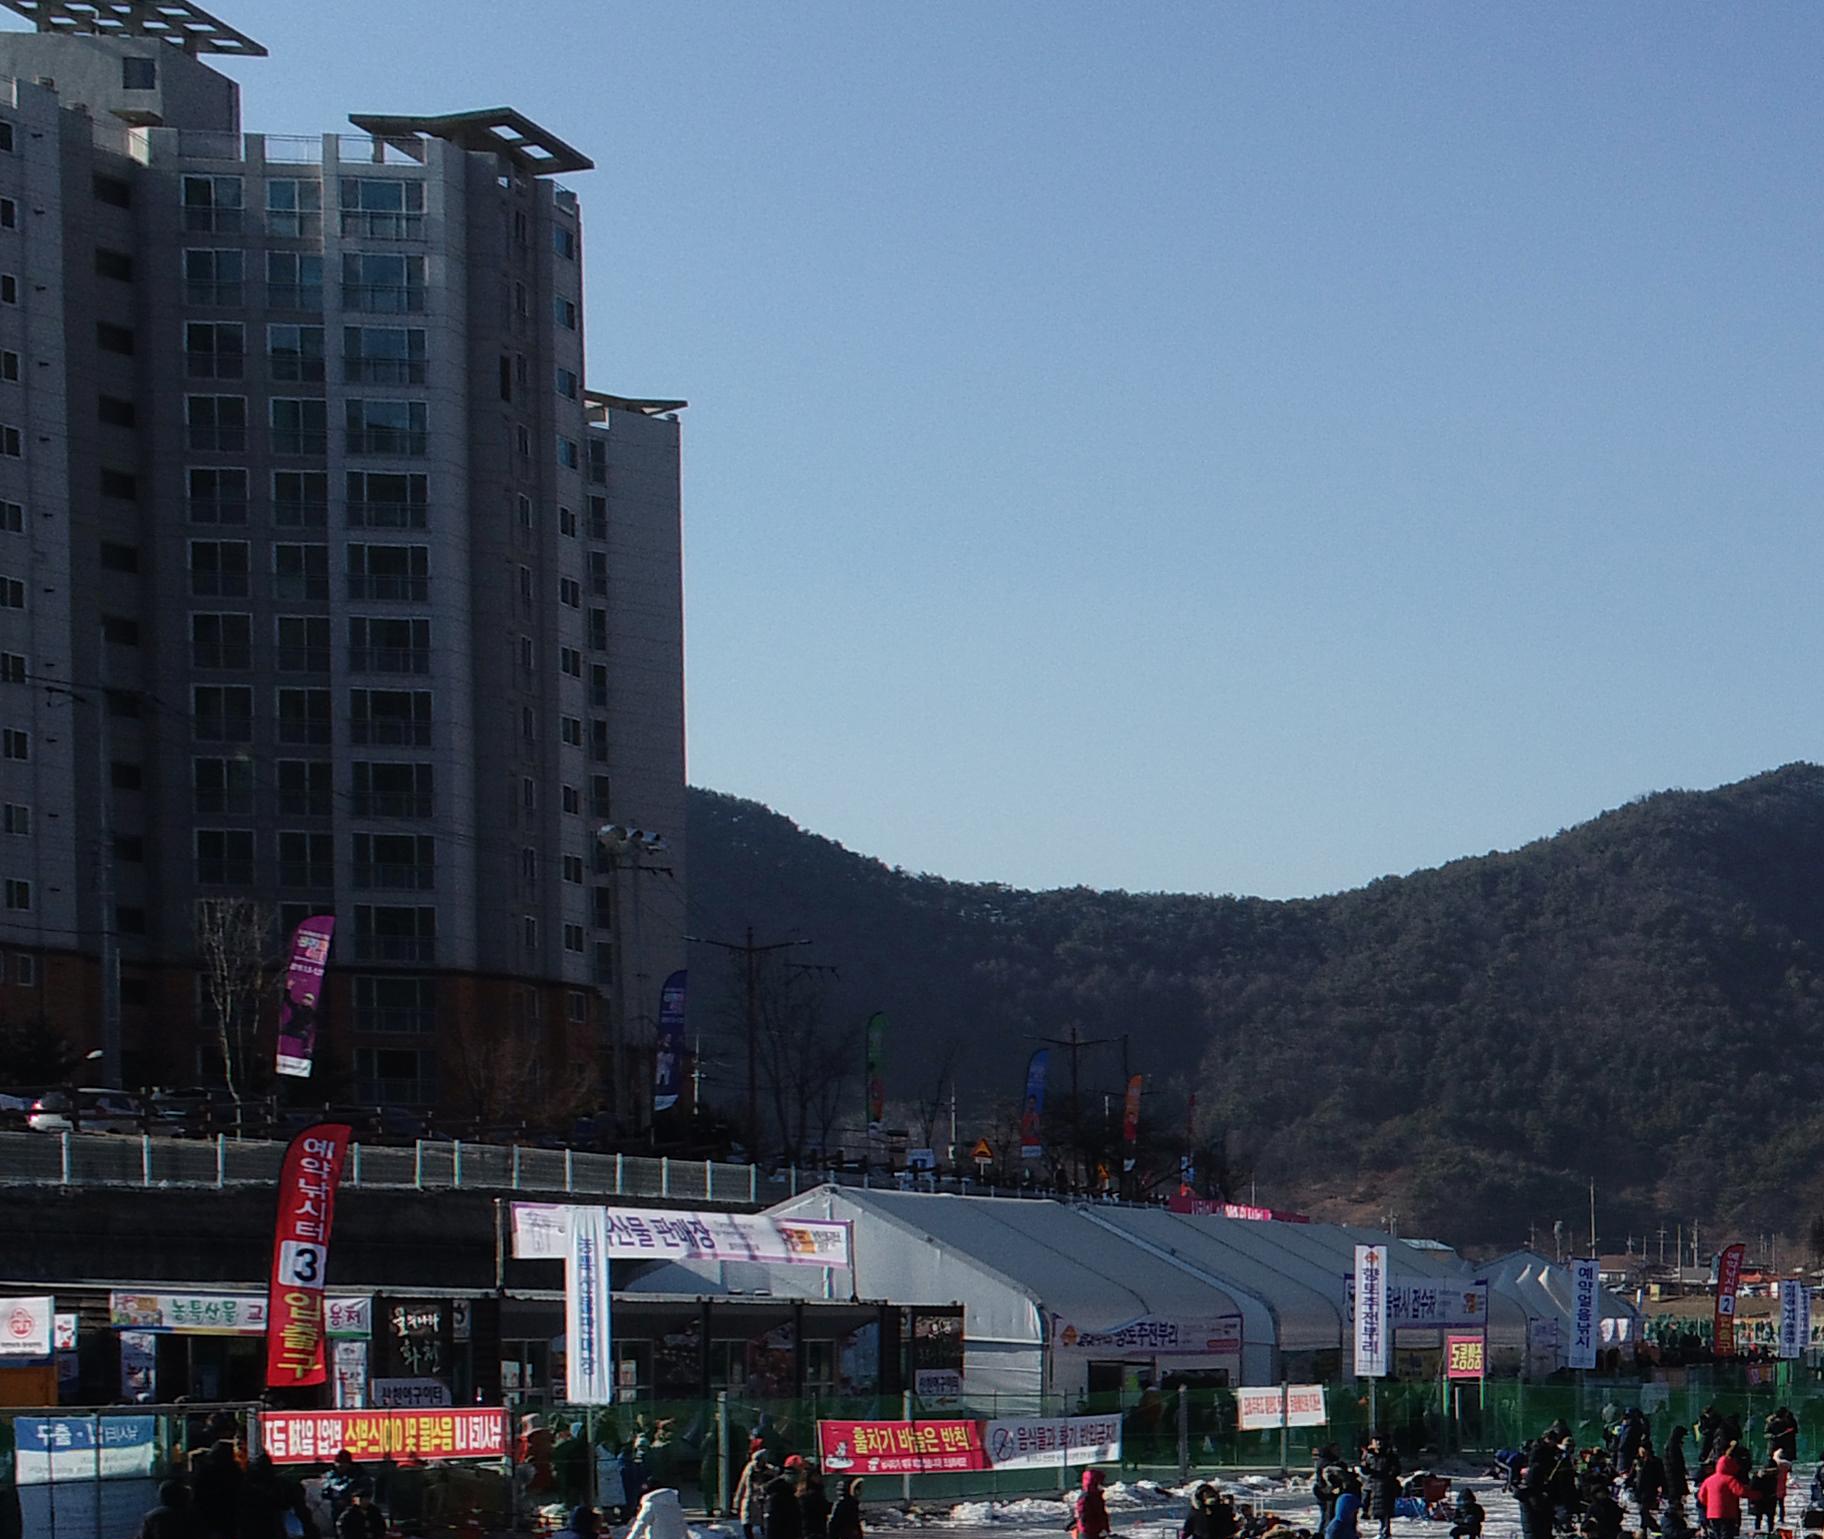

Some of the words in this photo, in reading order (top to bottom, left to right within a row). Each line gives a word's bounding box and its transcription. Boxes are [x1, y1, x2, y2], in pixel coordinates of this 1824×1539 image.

[294, 1137, 336, 1242] 예약낚시터
[294, 1248, 318, 1282] 3
[1575, 1267, 1594, 1349] 예약얼음낚시
[1721, 1297, 1732, 1315] 2
[277, 1292, 323, 1379] 입출구
[852, 1426, 897, 1454] 훌치기
